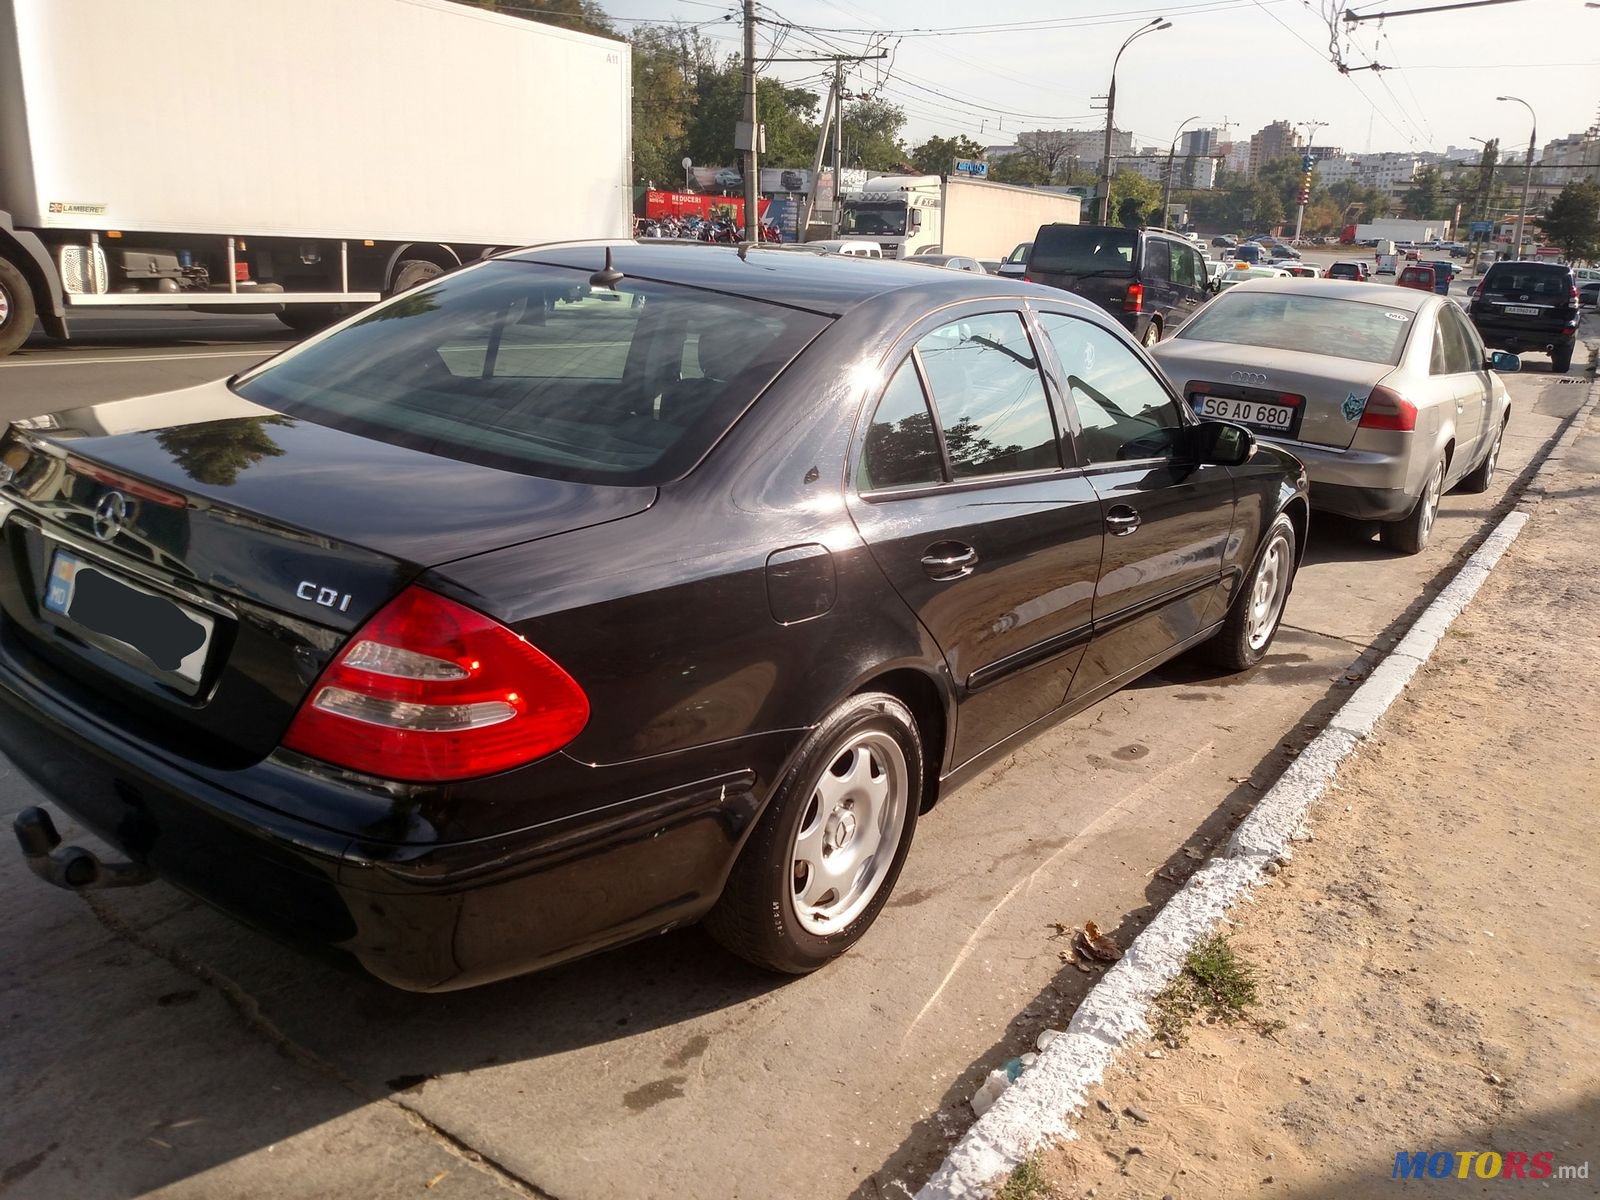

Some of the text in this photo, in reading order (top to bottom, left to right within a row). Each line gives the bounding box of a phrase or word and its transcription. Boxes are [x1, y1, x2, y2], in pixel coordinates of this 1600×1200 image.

[63, 205, 105, 213] LAMBERET
[1204, 399, 1228, 416] SG
[1256, 406, 1288, 425] 680
[296, 580, 352, 612] CDI
